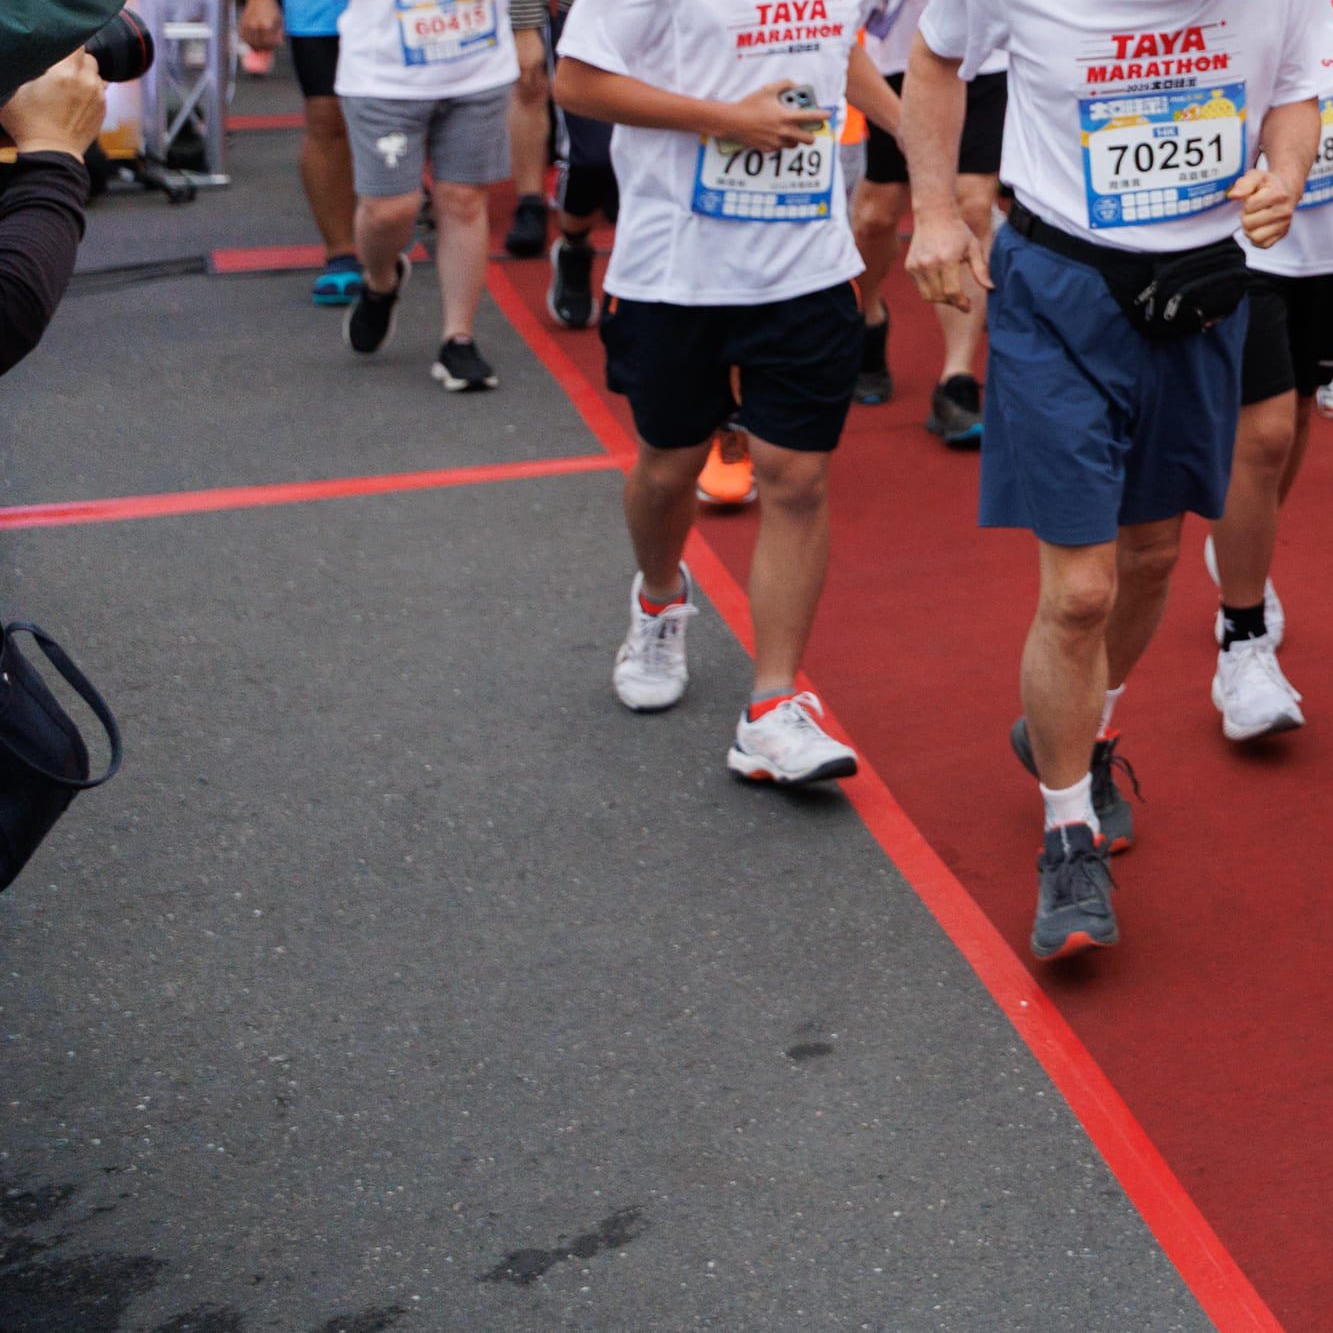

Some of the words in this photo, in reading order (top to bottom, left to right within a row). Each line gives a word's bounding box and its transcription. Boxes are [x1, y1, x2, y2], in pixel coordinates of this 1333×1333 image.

[737, 23, 844, 49] MARATHON
[1112, 26, 1206, 60] TAYA
[1086, 53, 1228, 84] MARATHON
[723, 149, 822, 177] 70149
[1108, 133, 1222, 176] 70251
